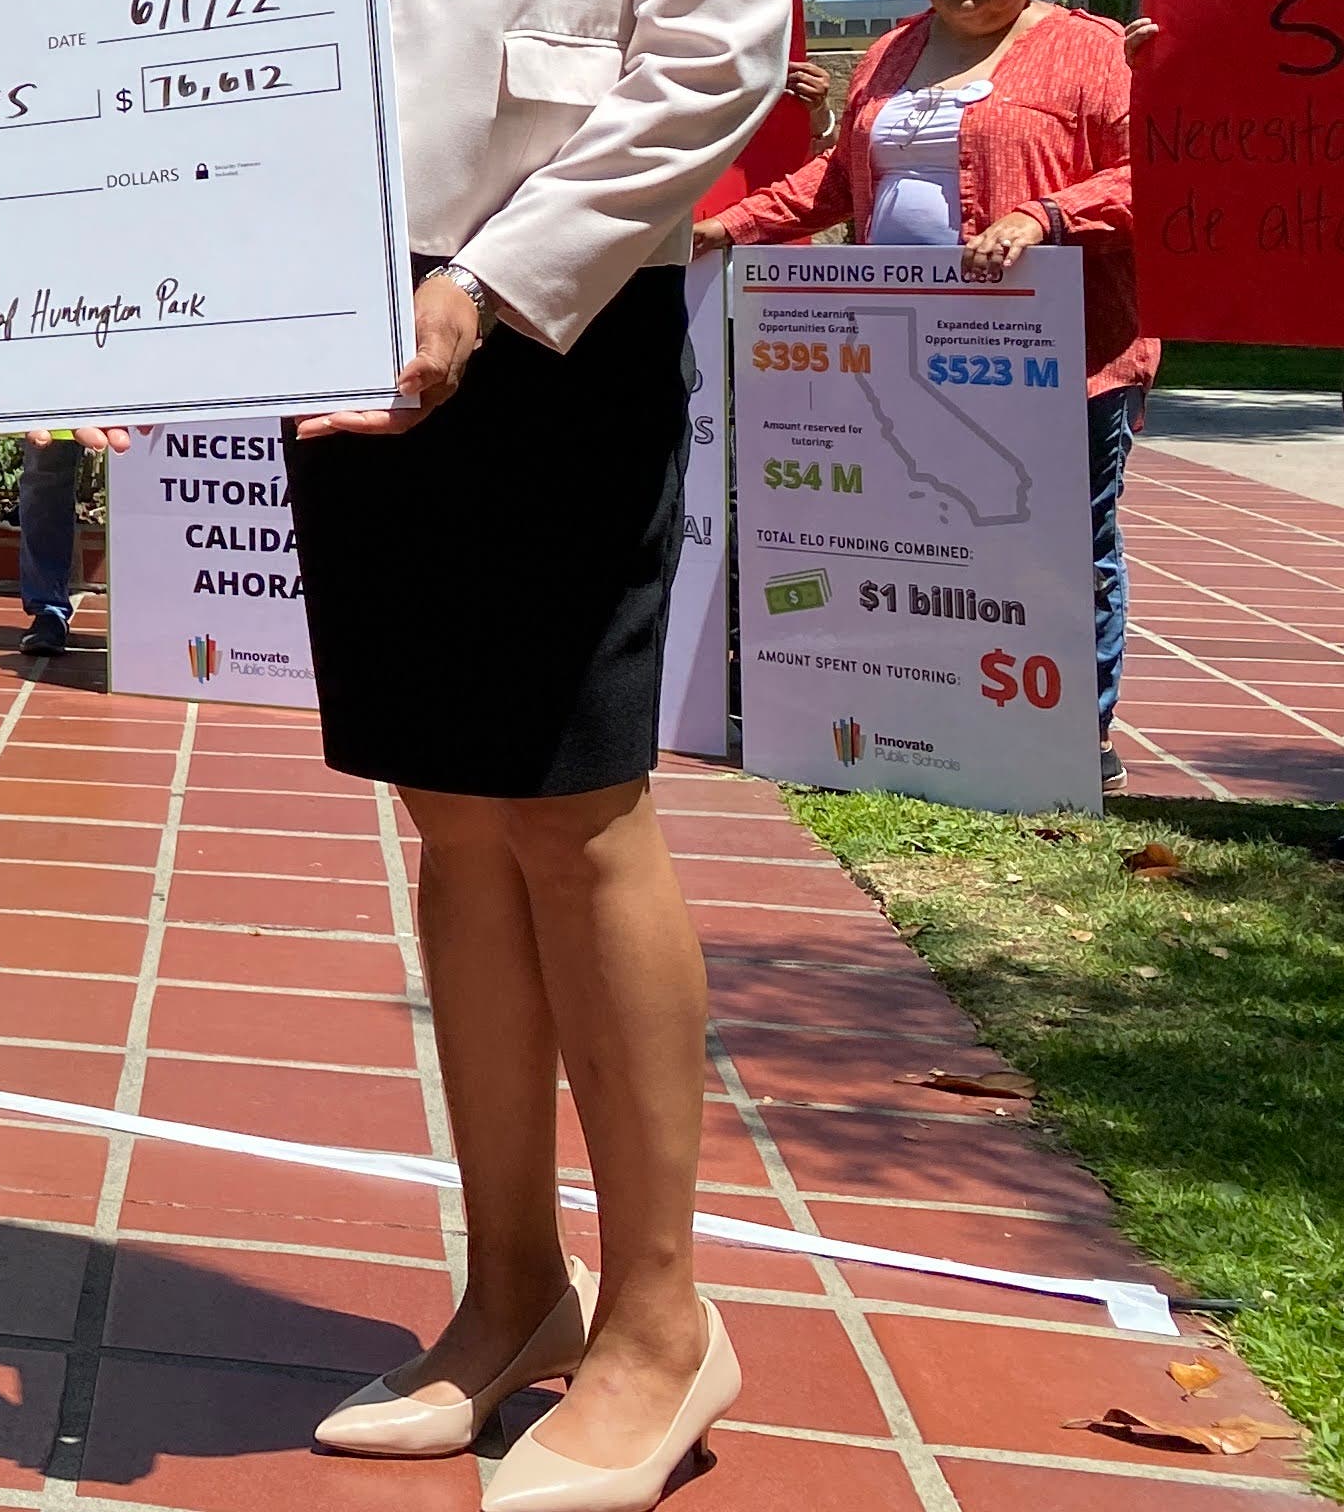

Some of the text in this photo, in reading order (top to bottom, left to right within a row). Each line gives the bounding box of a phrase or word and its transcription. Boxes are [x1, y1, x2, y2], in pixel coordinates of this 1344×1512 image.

[48, 33, 87, 50] DATE
[115, 65, 293, 113] $ 76,612
[106, 167, 180, 189] DOLLARS
[1162, 186, 1225, 254] de
[745, 264, 924, 283] ELO FUNDING FOR
[31, 289, 141, 349] Huntington
[156, 277, 206, 321] Park
[762, 308, 855, 322] Expanded Learning
[758, 322, 826, 336] Opportunities
[936, 319, 1042, 334] Expanded Learning
[925, 334, 1001, 347] Opportunities
[752, 340, 872, 374] $395 M
[927, 353, 1059, 388] $523 M
[763, 420, 863, 434] Amount reserved for
[791, 436, 833, 449] tutoring:
[763, 457, 863, 494] $54 M
[757, 529, 795, 544] TOTAL
[800, 533, 824, 546] ELO
[829, 535, 889, 552] FUNDING
[859, 579, 1026, 626] $1 billion
[230, 648, 290, 664] Innovate
[757, 649, 811, 667] AMOUNT
[816, 657, 857, 673] SPENT
[862, 663, 882, 676] ON
[230, 662, 265, 676] Public
[980, 648, 1062, 710] $0
[874, 733, 934, 753] Innovate
[875, 748, 961, 772] Public Schools
